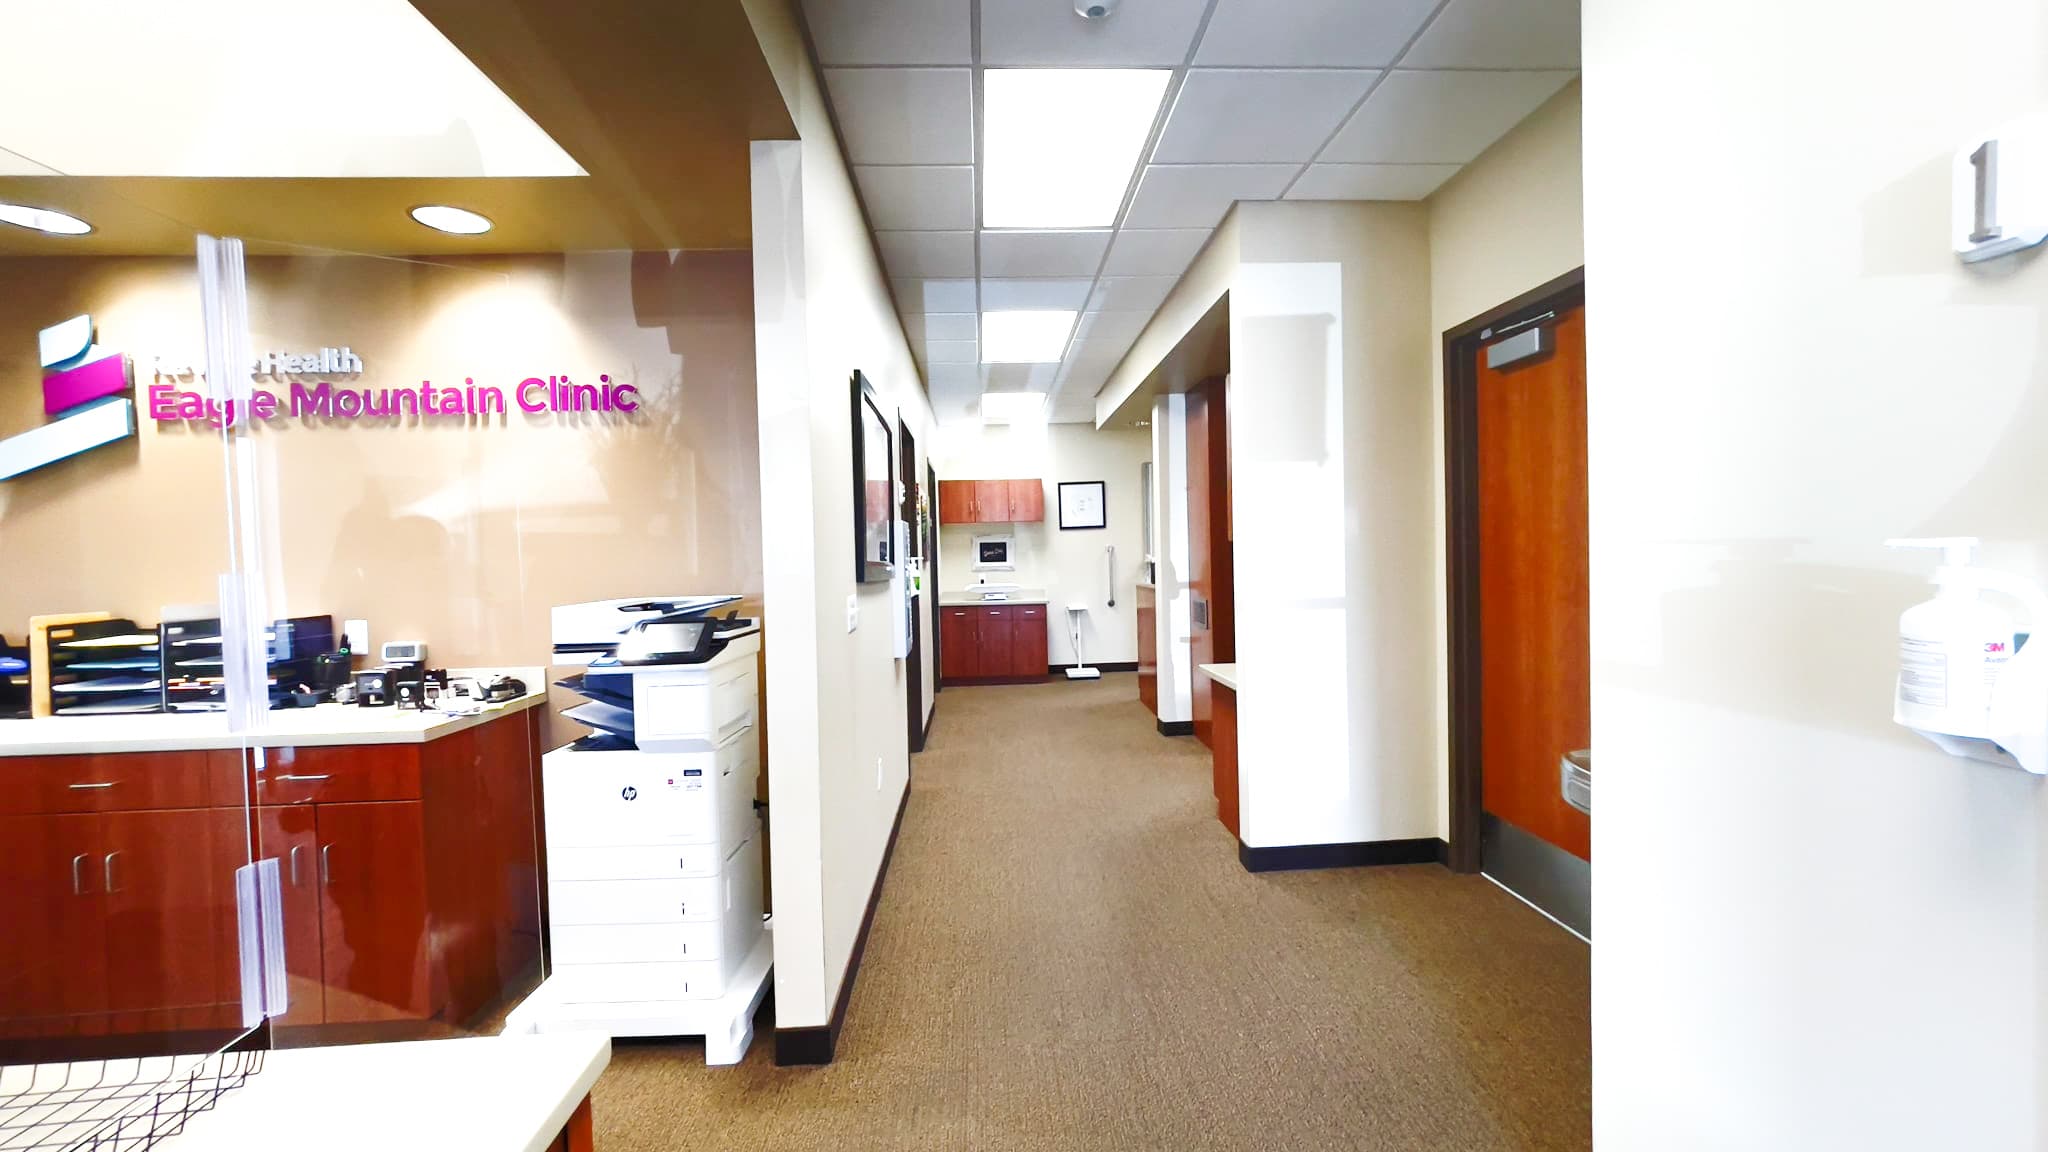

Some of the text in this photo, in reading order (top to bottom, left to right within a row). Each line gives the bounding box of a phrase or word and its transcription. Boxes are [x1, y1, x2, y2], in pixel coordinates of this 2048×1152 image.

[264, 347, 363, 374] Health
[290, 377, 505, 419] Mountain
[516, 374, 640, 413] Clinic
[1984, 642, 2005, 653] 3M
[622, 786, 637, 801] hp
